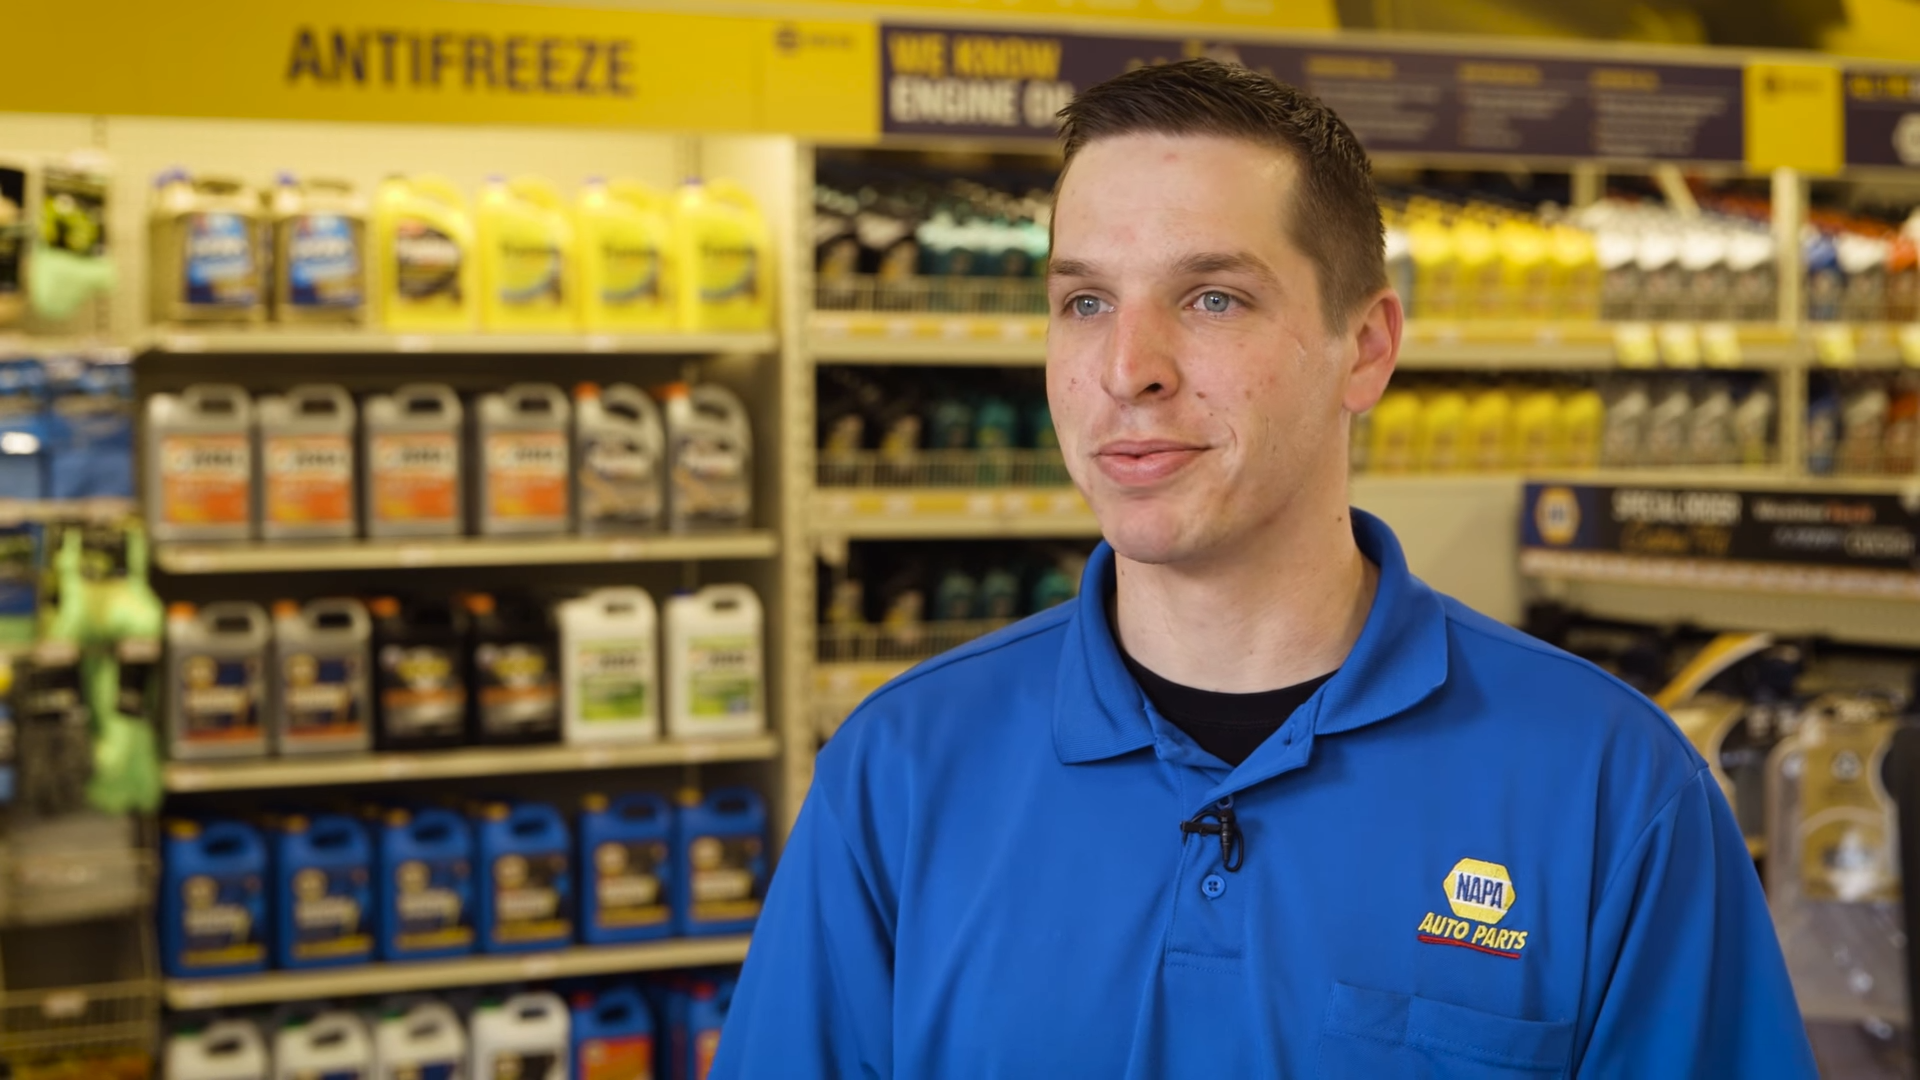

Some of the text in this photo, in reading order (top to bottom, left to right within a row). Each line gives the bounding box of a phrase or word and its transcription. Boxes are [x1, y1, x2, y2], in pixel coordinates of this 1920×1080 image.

[286, 26, 636, 97] ANTIFREEZE
[887, 33, 947, 77] WE
[952, 36, 1062, 79] KNOW
[889, 76, 1020, 126] ENGINE
[1456, 872, 1504, 909] NAPA
[1418, 912, 1528, 950] AUTO PARTS
